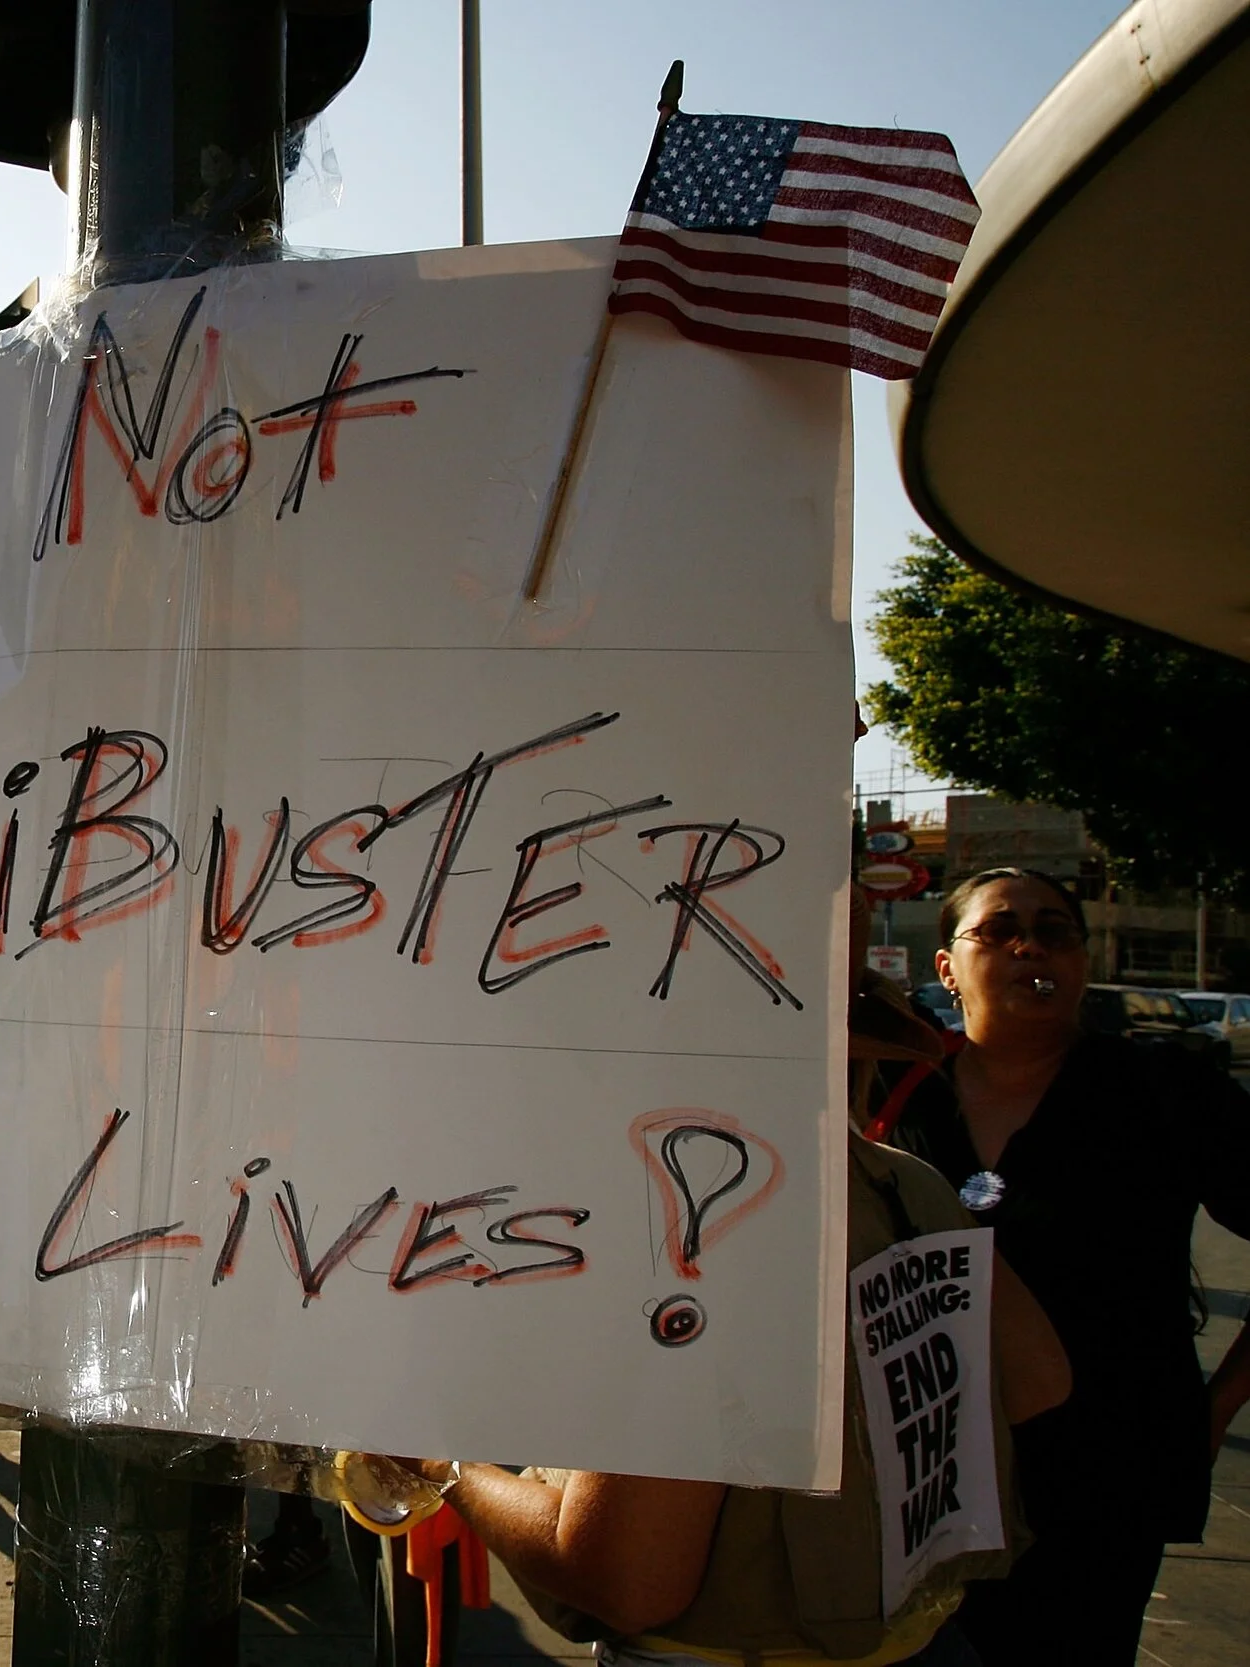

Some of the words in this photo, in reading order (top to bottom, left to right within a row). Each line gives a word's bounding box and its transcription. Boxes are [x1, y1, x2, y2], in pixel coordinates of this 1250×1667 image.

[858, 1270, 890, 1319] NO
[889, 1246, 970, 1300] MORE
[865, 1283, 971, 1357] STALLING:
[883, 1332, 959, 1426] END
[896, 1391, 960, 1493] THE
[900, 1458, 961, 1558] WAR
